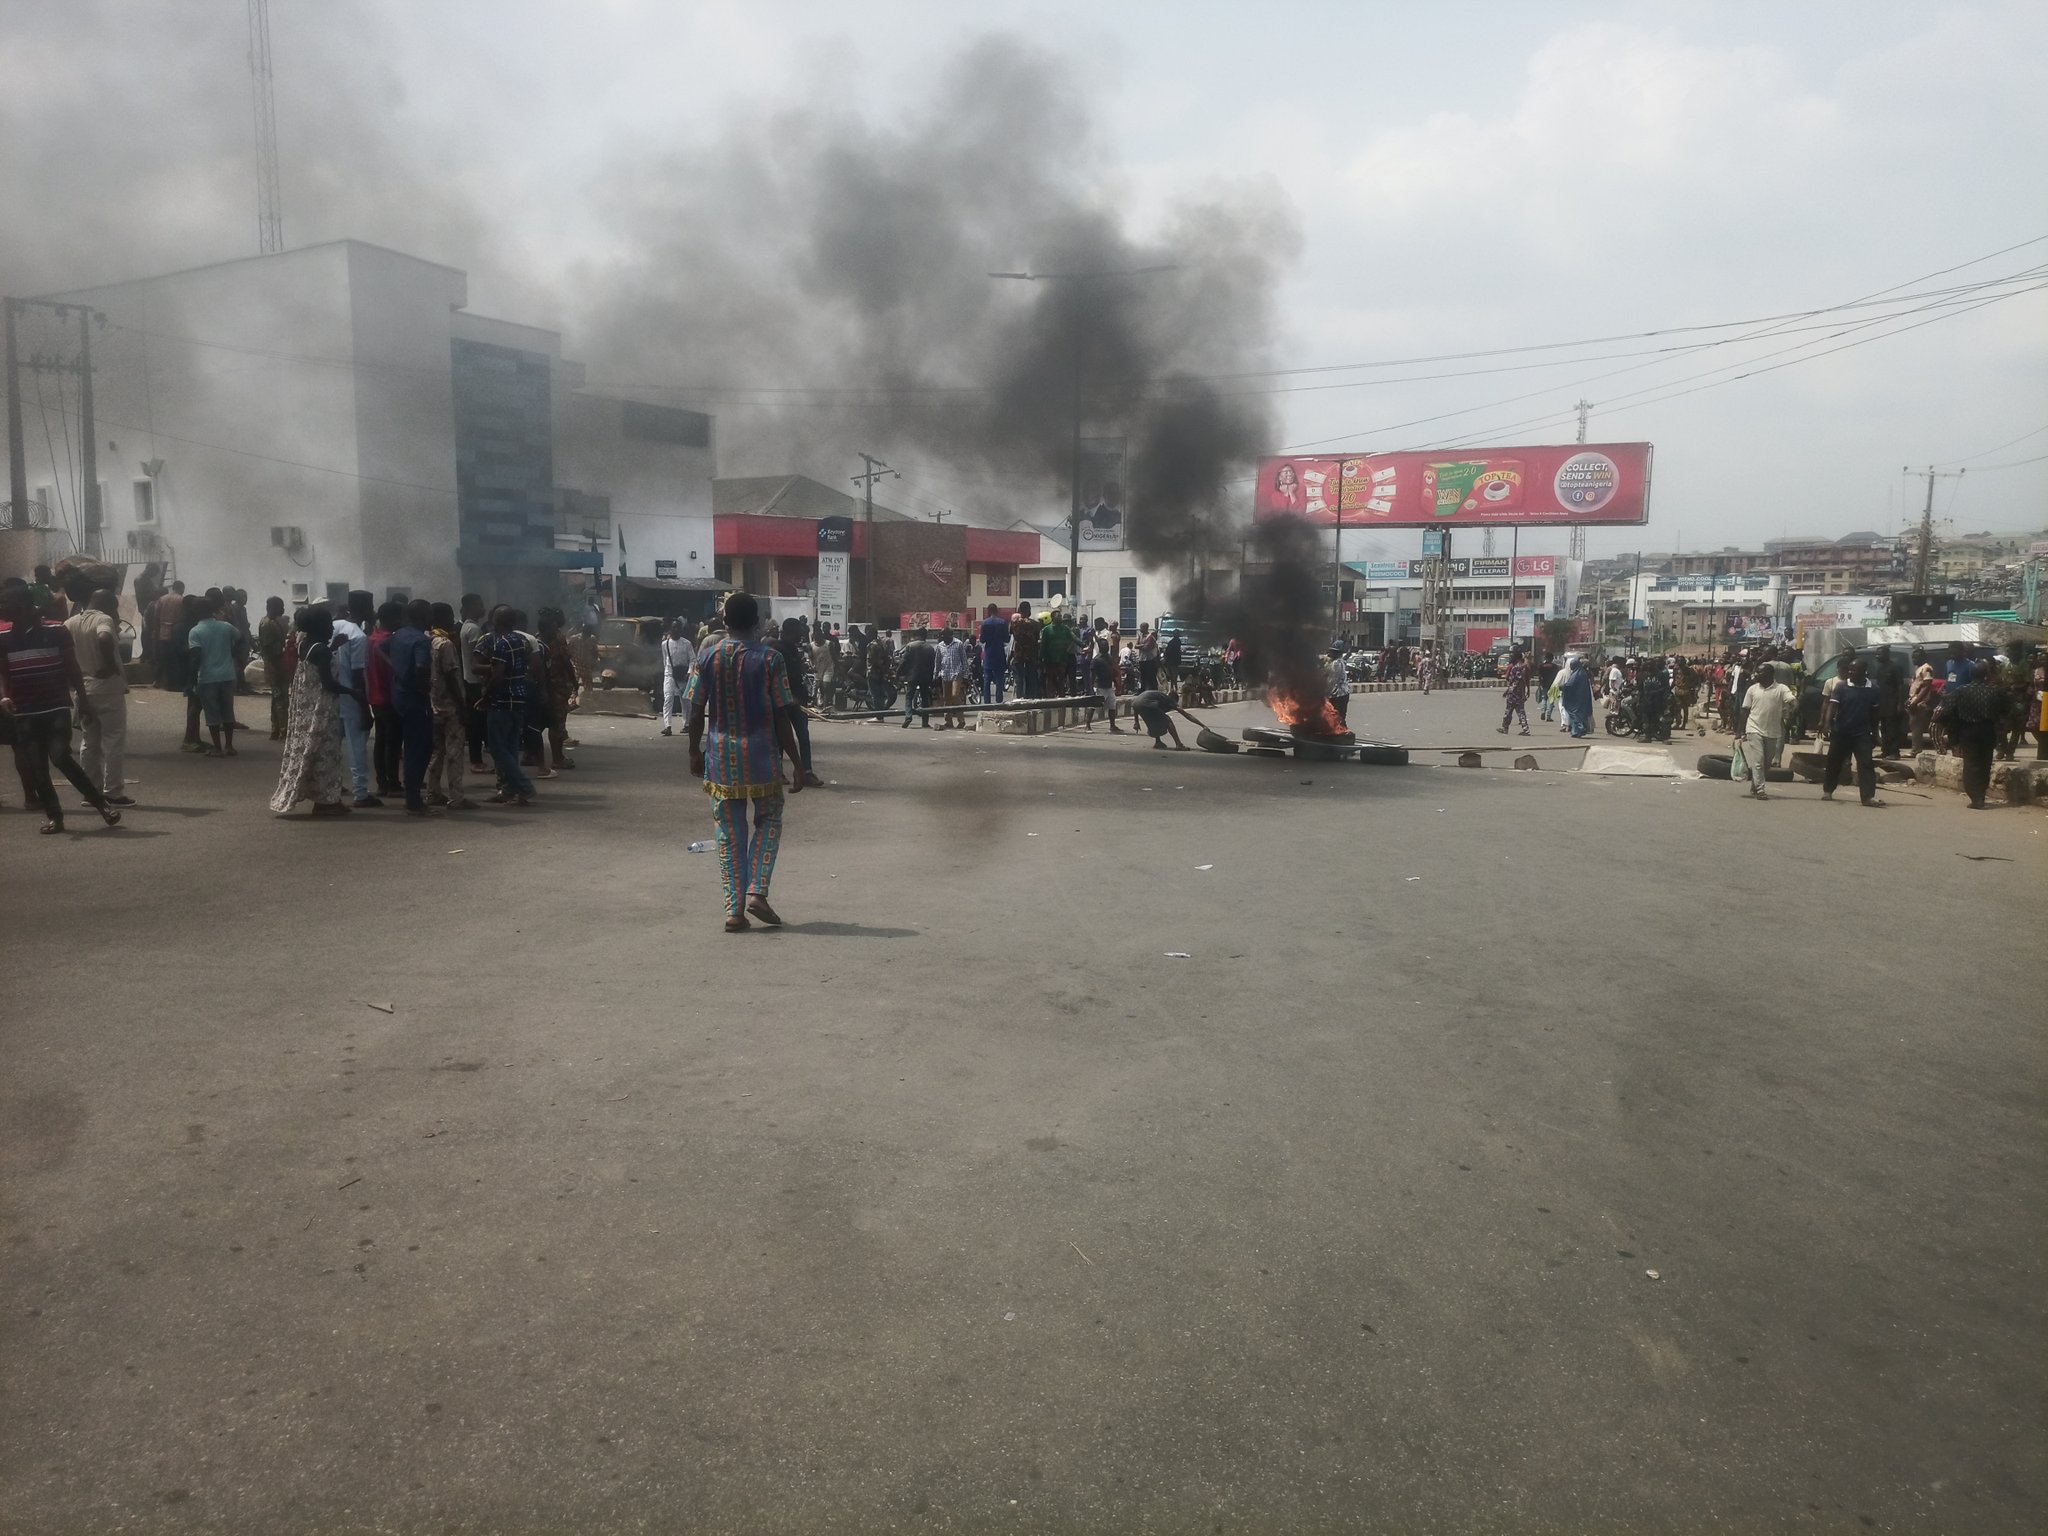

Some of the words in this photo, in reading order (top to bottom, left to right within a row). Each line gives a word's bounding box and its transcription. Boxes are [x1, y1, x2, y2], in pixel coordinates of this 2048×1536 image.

[1566, 463, 1608, 472] COLLECT,
[1480, 473, 1498, 483] TOP
[1500, 472, 1517, 481] TEA
[1561, 472, 1585, 480] SEND
[1585, 472, 1592, 480] &
[1593, 471, 1612, 479] WIN
[1533, 560, 1550, 571] LG
